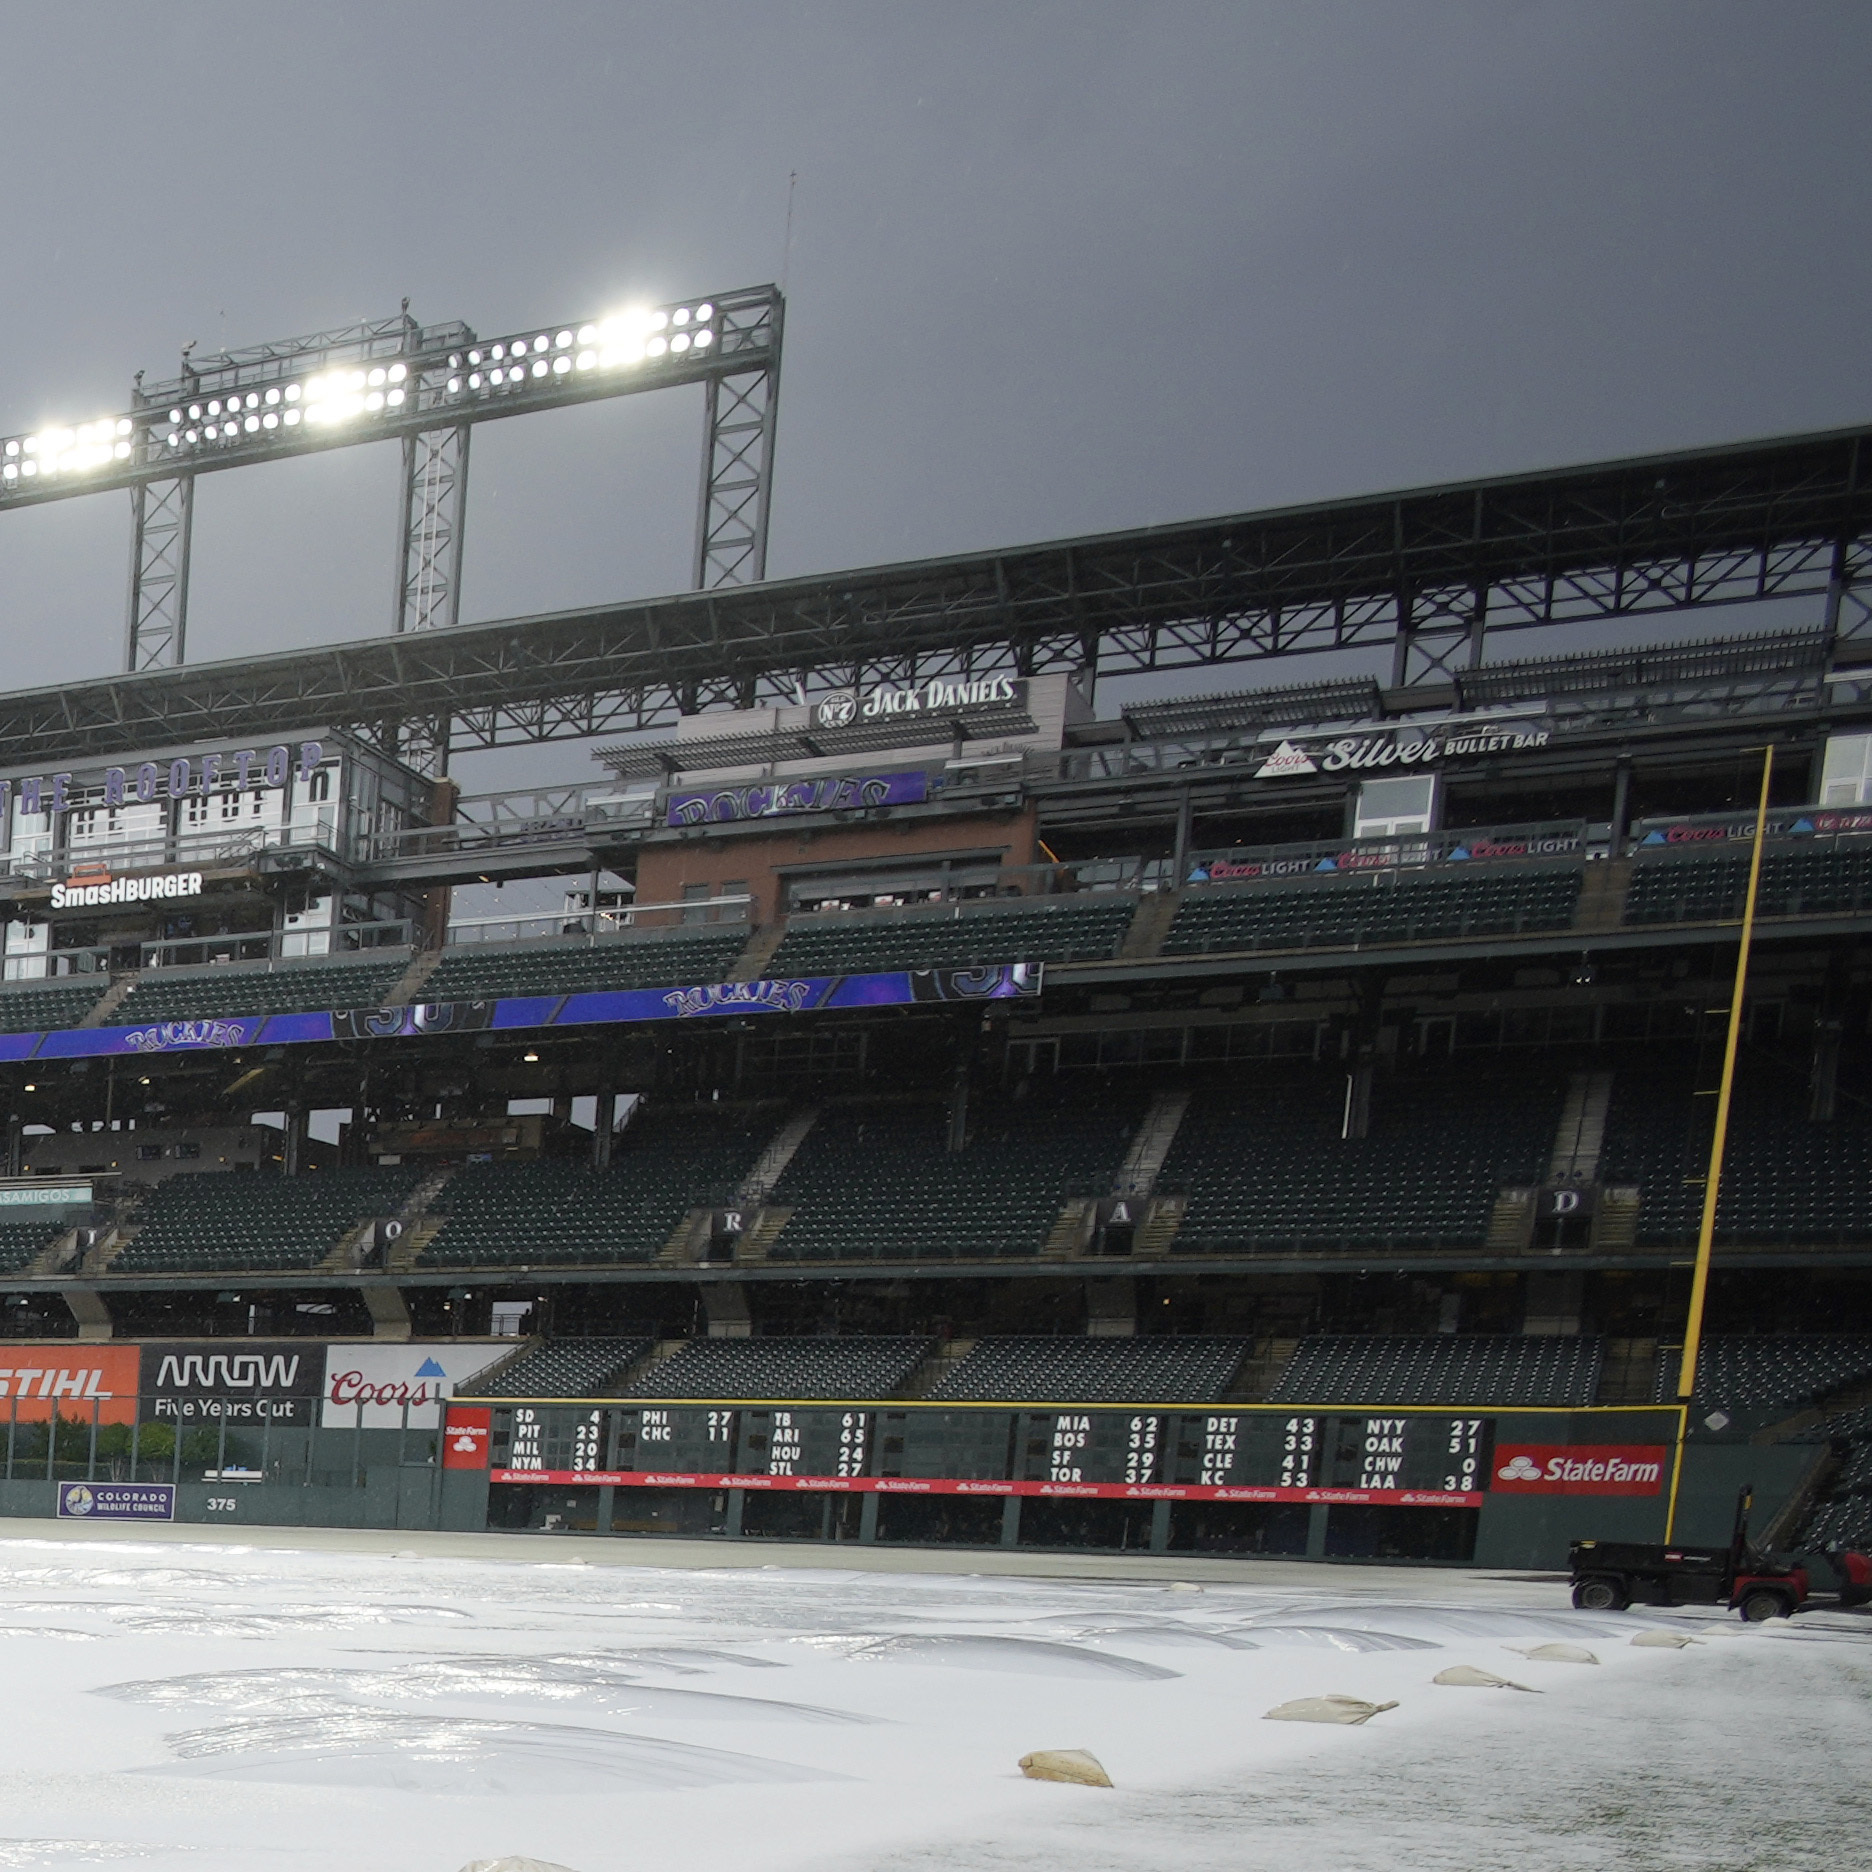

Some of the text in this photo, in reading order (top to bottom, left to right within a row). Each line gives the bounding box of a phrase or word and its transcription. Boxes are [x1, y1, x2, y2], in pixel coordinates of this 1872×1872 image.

[1322, 732, 1549, 772] Silver BULLET BAR
[104, 742, 323, 808] ROOFTOP
[1261, 860, 1310, 876] LIGHT
[331, 1370, 429, 1406] Coors
[516, 1409, 600, 1423] SD 4
[642, 1411, 732, 1426] PHI 27
[775, 1413, 865, 1427] TB 61
[1057, 1416, 1157, 1431] MIA 62
[518, 1425, 598, 1440] PIT 23
[1207, 1418, 1314, 1433] DET 43
[1367, 1420, 1481, 1435] NYY 27
[641, 1427, 728, 1441] CHC 11
[773, 1429, 864, 1443] ARI 65
[1054, 1433, 1155, 1448] BOS 35
[513, 1442, 597, 1456] MIL 20
[1206, 1435, 1312, 1450] TEX 33
[1365, 1438, 1477, 1453] OAK 51
[772, 1447, 863, 1461] HOU 24
[1052, 1451, 1154, 1467] SF 29
[1203, 1453, 1309, 1469] CLE 41
[512, 1457, 596, 1471] NYM 34
[769, 1462, 862, 1477] STL 27
[1364, 1457, 1476, 1473] CHW 0
[1051, 1468, 1153, 1483] TOR 37
[1201, 1471, 1308, 1487] KC 53
[1360, 1474, 1473, 1491] LAA 38
[97, 1491, 167, 1503] COLORADO
[207, 1498, 236, 1511] 375
